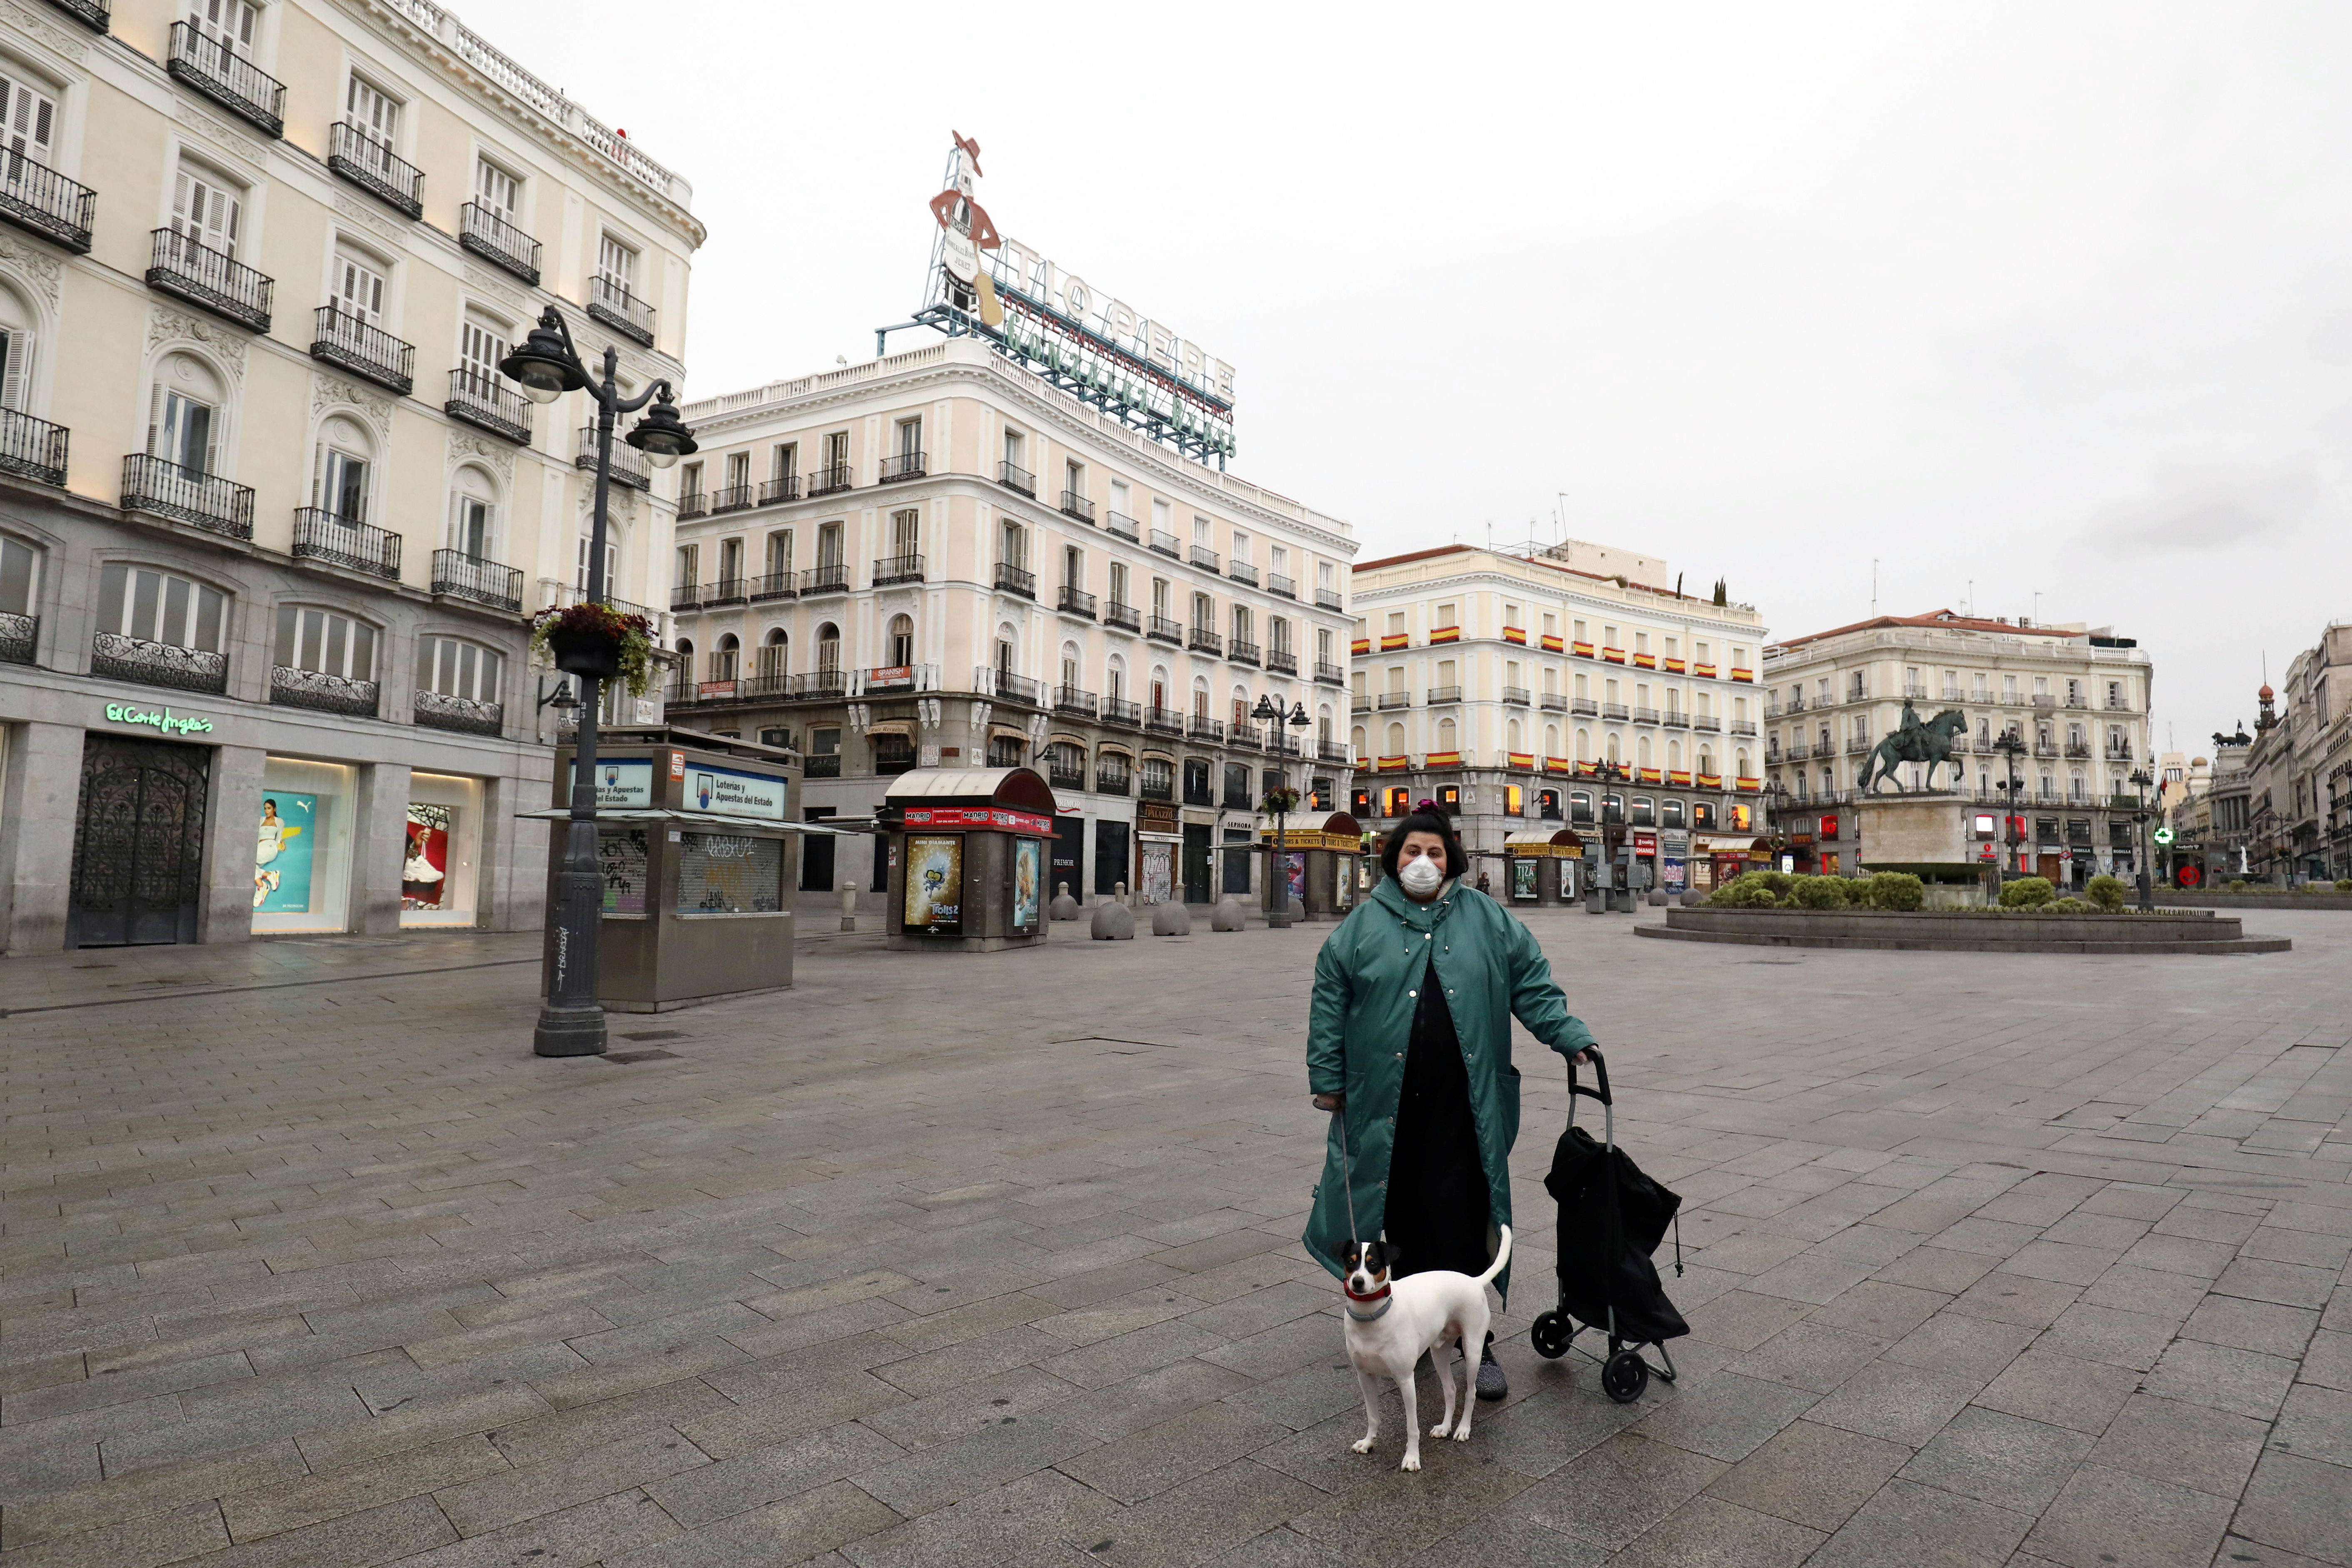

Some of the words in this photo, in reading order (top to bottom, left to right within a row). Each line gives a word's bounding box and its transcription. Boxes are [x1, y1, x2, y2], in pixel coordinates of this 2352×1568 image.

[955, 257, 971, 271] JEREZ
[1009, 237, 1093, 321] TIO
[1111, 297, 1236, 406] PEPE
[1004, 294, 1036, 322] SOL
[1042, 313, 1060, 334] DE
[1067, 327, 1144, 376] ANDALUCIA
[1148, 370, 1234, 426] EMBOTELLADO
[1006, 313, 1148, 414] GONZALEZ
[1172, 396, 1237, 458] BYASS
[878, 668, 903, 676] SPANISH
[106, 703, 123, 720] El
[123, 706, 161, 725] Corte
[161, 707, 213, 735] Inglés
[613, 786, 643, 795] Apuestas
[716, 780, 740, 790] Loterías
[716, 792, 743, 804] Apuestas
[744, 795, 753, 804] del
[754, 797, 772, 806] Estado
[1056, 799, 1080, 809] PRIMOR
[993, 812, 1008, 821] MADRID
[1148, 810, 1172, 819] PALAZZO
[1037, 819, 1050, 828] MADRID
[1517, 866, 1534, 882] TIZA
[930, 903, 953, 915] Trolls
[953, 905, 958, 914] 2
